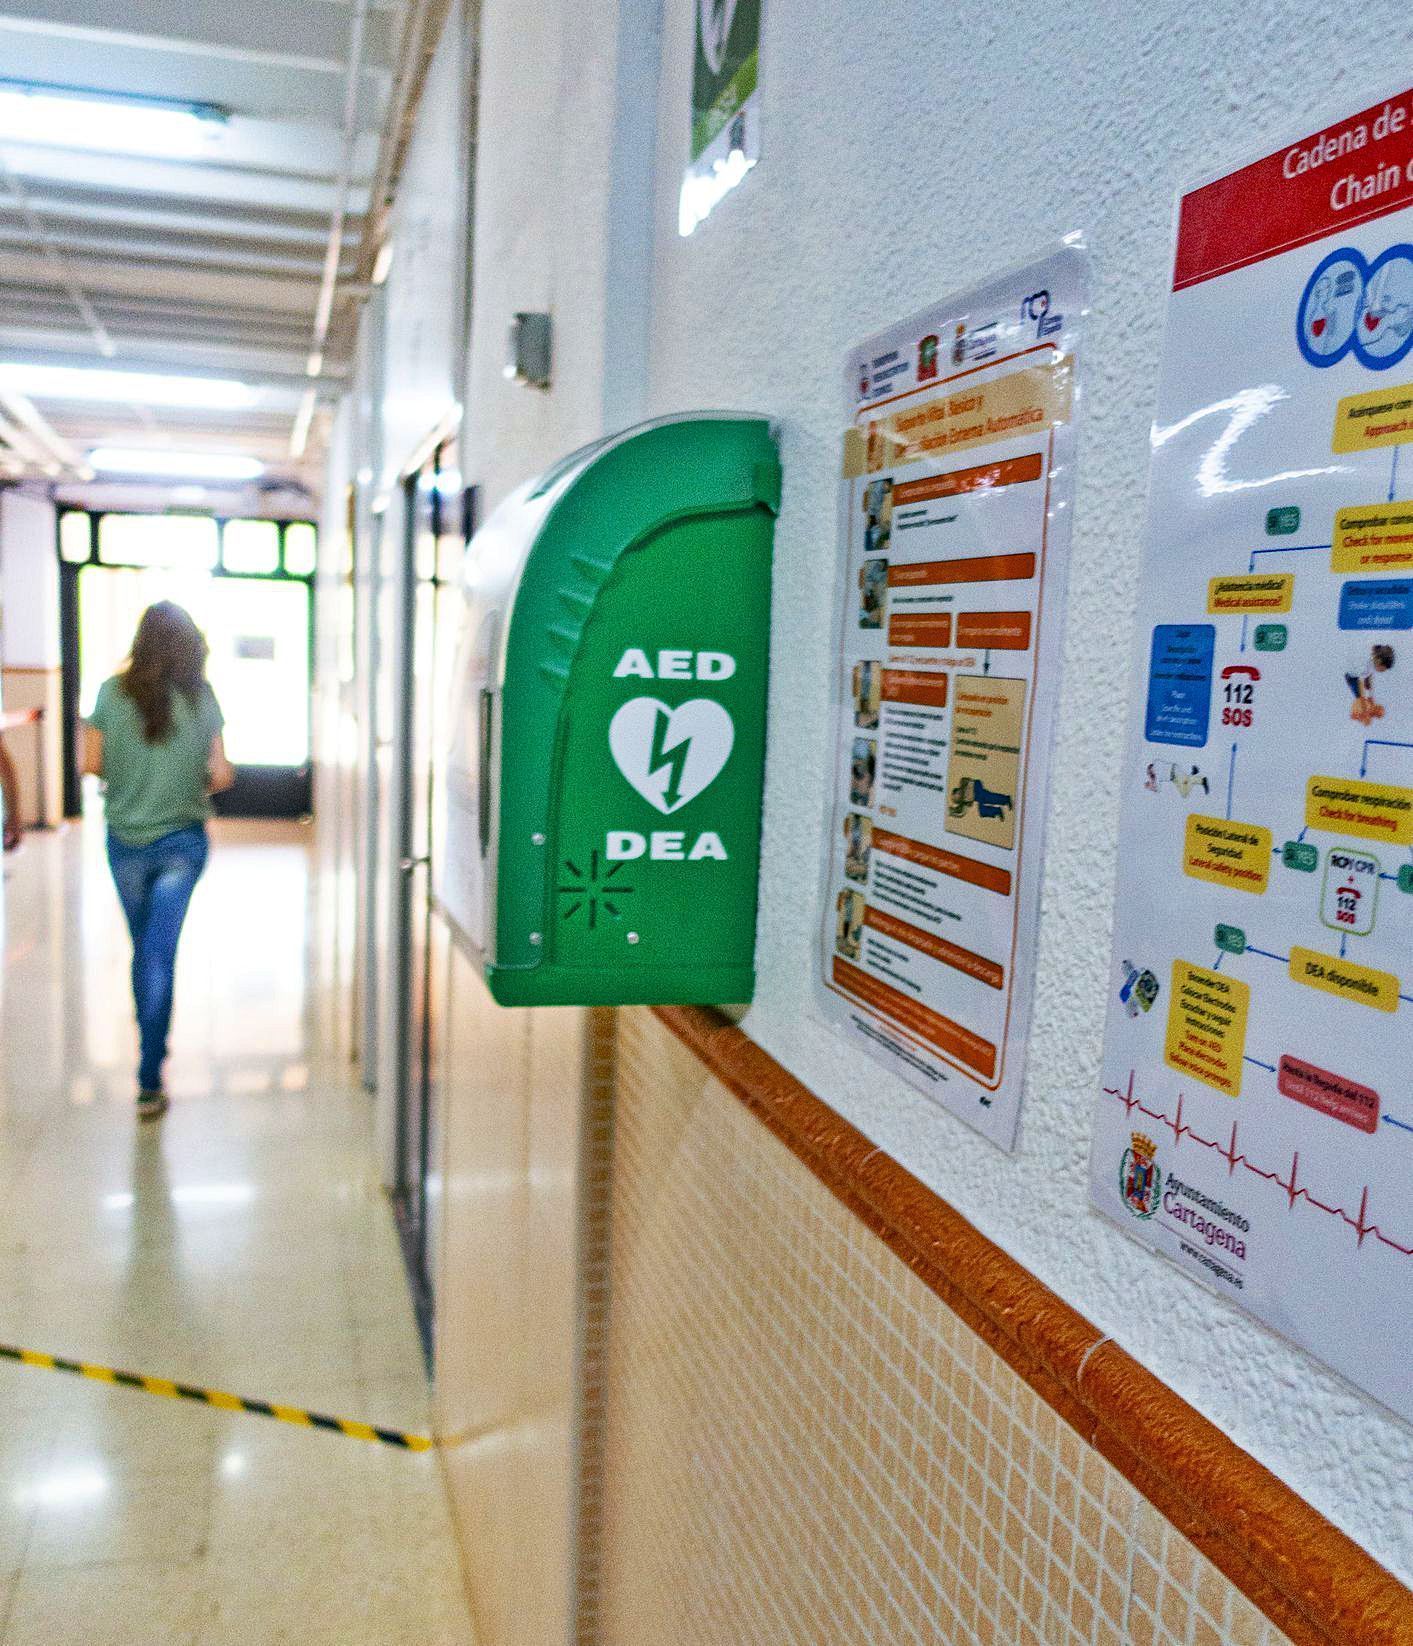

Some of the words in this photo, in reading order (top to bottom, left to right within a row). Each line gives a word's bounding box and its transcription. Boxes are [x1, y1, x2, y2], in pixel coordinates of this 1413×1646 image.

[1281, 124, 1368, 180] Cadena
[1372, 103, 1407, 138] de
[1329, 162, 1401, 212] Chain
[613, 648, 737, 681] AED
[1223, 683, 1254, 704] 112
[1221, 707, 1253, 728] SOS
[605, 831, 729, 862] DEA
[1336, 910, 1356, 925] SOS
[1337, 896, 1357, 912] 112
[1326, 969, 1380, 997] disponible
[1165, 1172, 1251, 1233] Ayuntamiento
[1162, 1191, 1247, 1261] Cartagena
